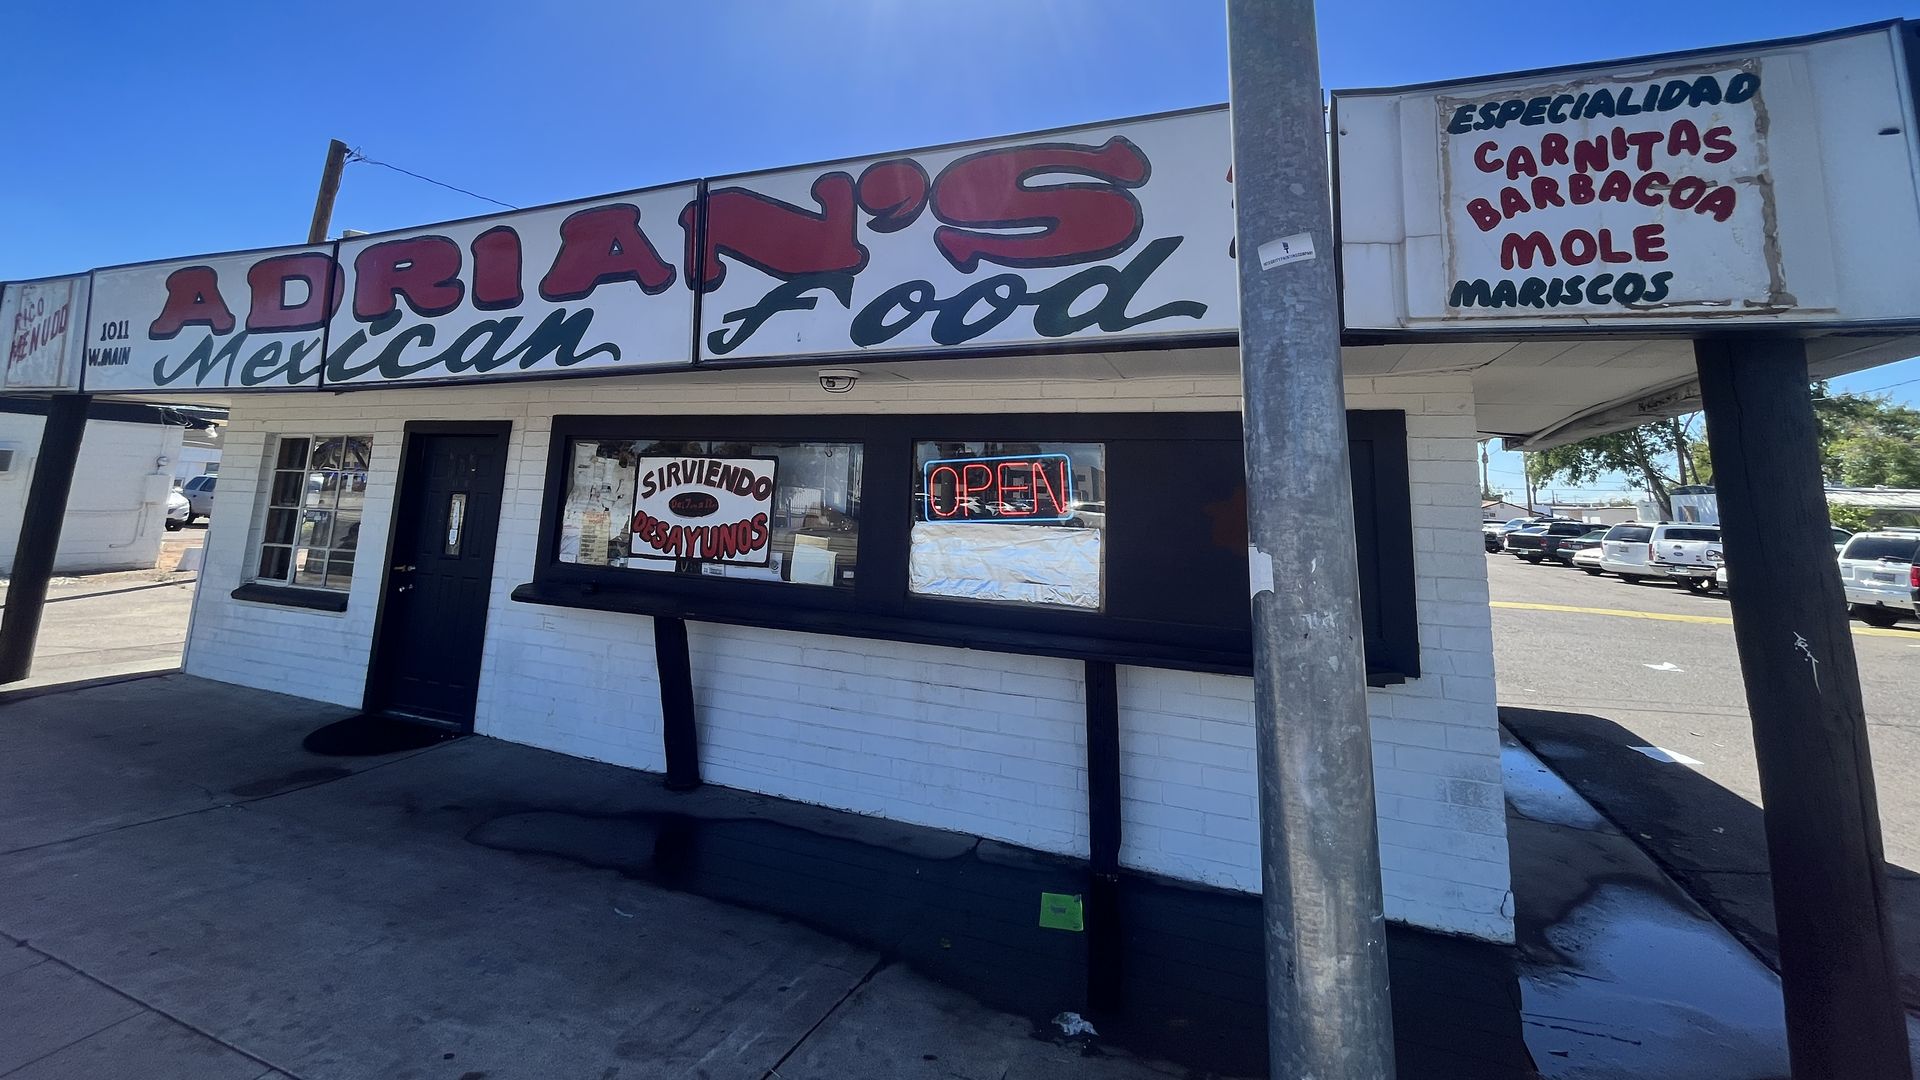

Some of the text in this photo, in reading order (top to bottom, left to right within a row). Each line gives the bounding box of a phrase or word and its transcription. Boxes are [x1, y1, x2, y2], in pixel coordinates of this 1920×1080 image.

[1447, 72, 1761, 135] ESPECIALIDAD
[1474, 119, 1737, 181] CARNITAS
[1466, 169, 1737, 232] BARBACOA
[149, 135, 1151, 340] ADRIAN'S
[1500, 223, 1670, 270] MOLE
[14, 296, 44, 334] RICO
[153, 235, 1208, 387] Mexican Food
[1449, 271, 1674, 309] MARISCOS
[7, 303, 70, 370] MENUDO
[100, 319, 130, 342] 1011
[641, 459, 773, 501] SIRVIENDO
[930, 461, 1066, 517] OPEN
[632, 510, 769, 560] DESAYUNOS
